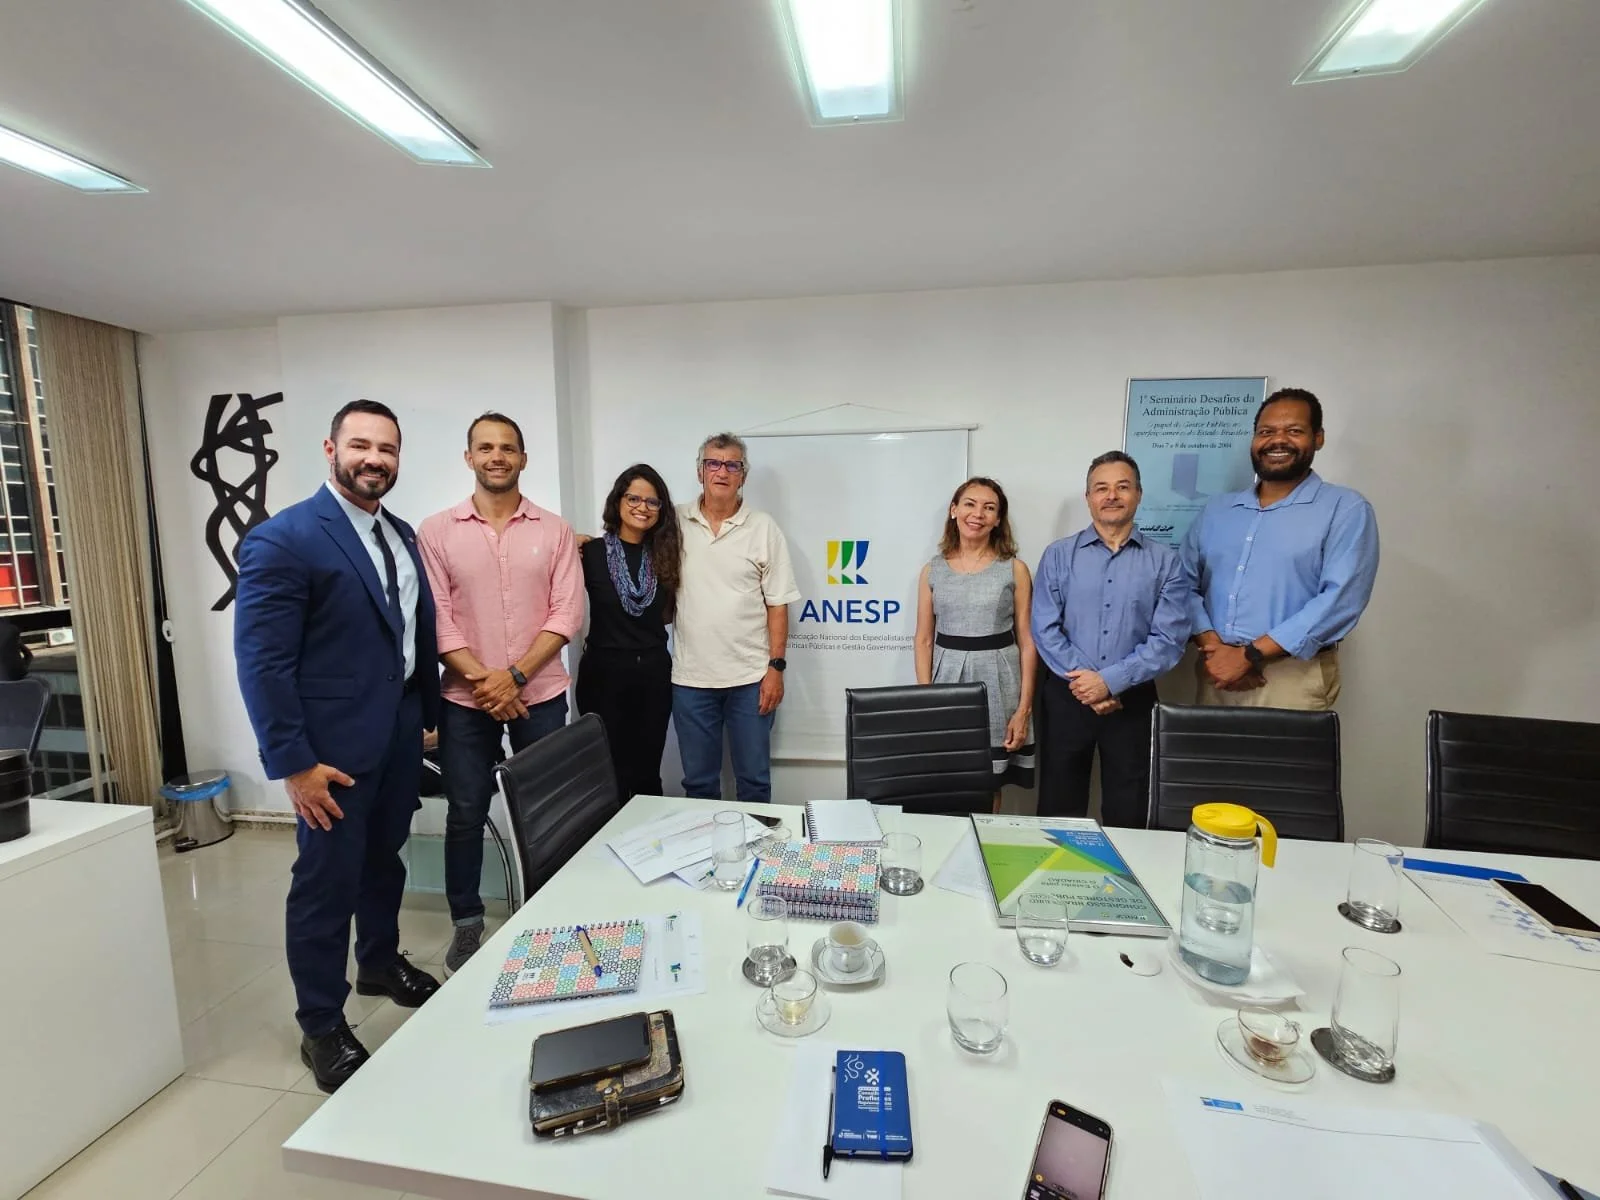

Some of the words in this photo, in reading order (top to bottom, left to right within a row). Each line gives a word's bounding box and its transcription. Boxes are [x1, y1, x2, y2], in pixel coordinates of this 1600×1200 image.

[1149, 394, 1197, 404] Seminário
[1200, 394, 1240, 403] Desafios
[1243, 393, 1255, 403] da
[1142, 407, 1210, 417] Administração
[1213, 406, 1248, 416] Pública
[799, 599, 901, 624] ANESP
[788, 633, 819, 642] ssociação
[820, 633, 848, 641] Nacional
[862, 634, 905, 642] Especialistas
[786, 641, 808, 649] olíticas
[808, 642, 836, 650] Públicas
[842, 643, 866, 651] Gestão
[866, 644, 915, 652] Governament
